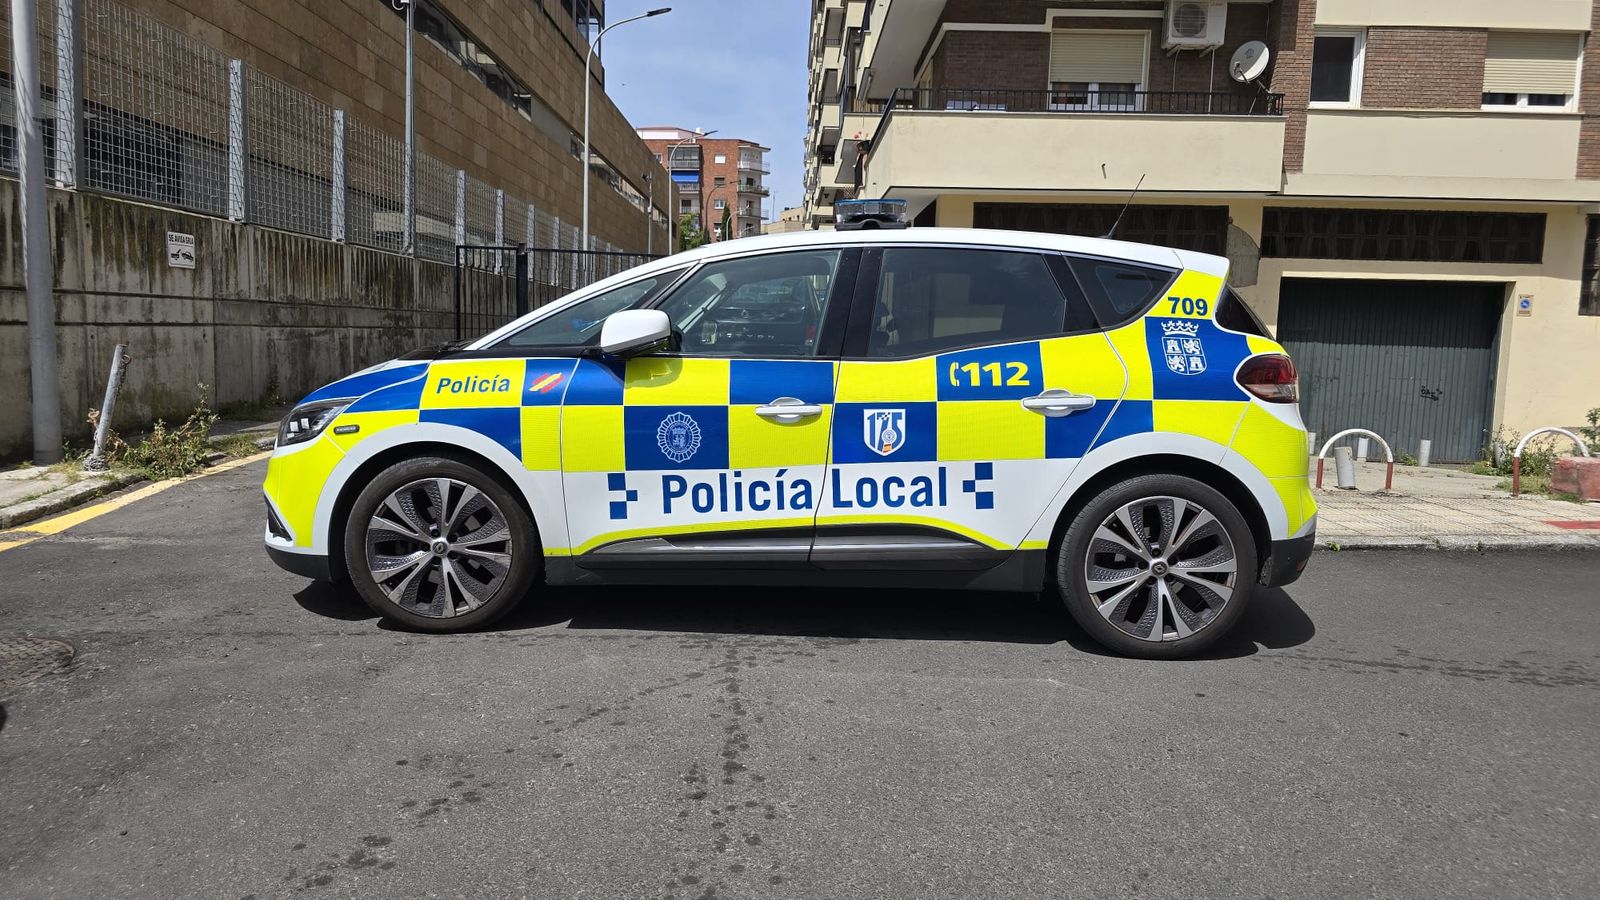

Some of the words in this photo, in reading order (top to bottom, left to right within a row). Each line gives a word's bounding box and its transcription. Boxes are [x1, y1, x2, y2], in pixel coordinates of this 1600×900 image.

[1167, 296, 1209, 316] 709
[436, 374, 511, 394] Policía
[960, 361, 1030, 387] 112
[661, 468, 813, 514] Policía
[831, 466, 947, 508] Local
